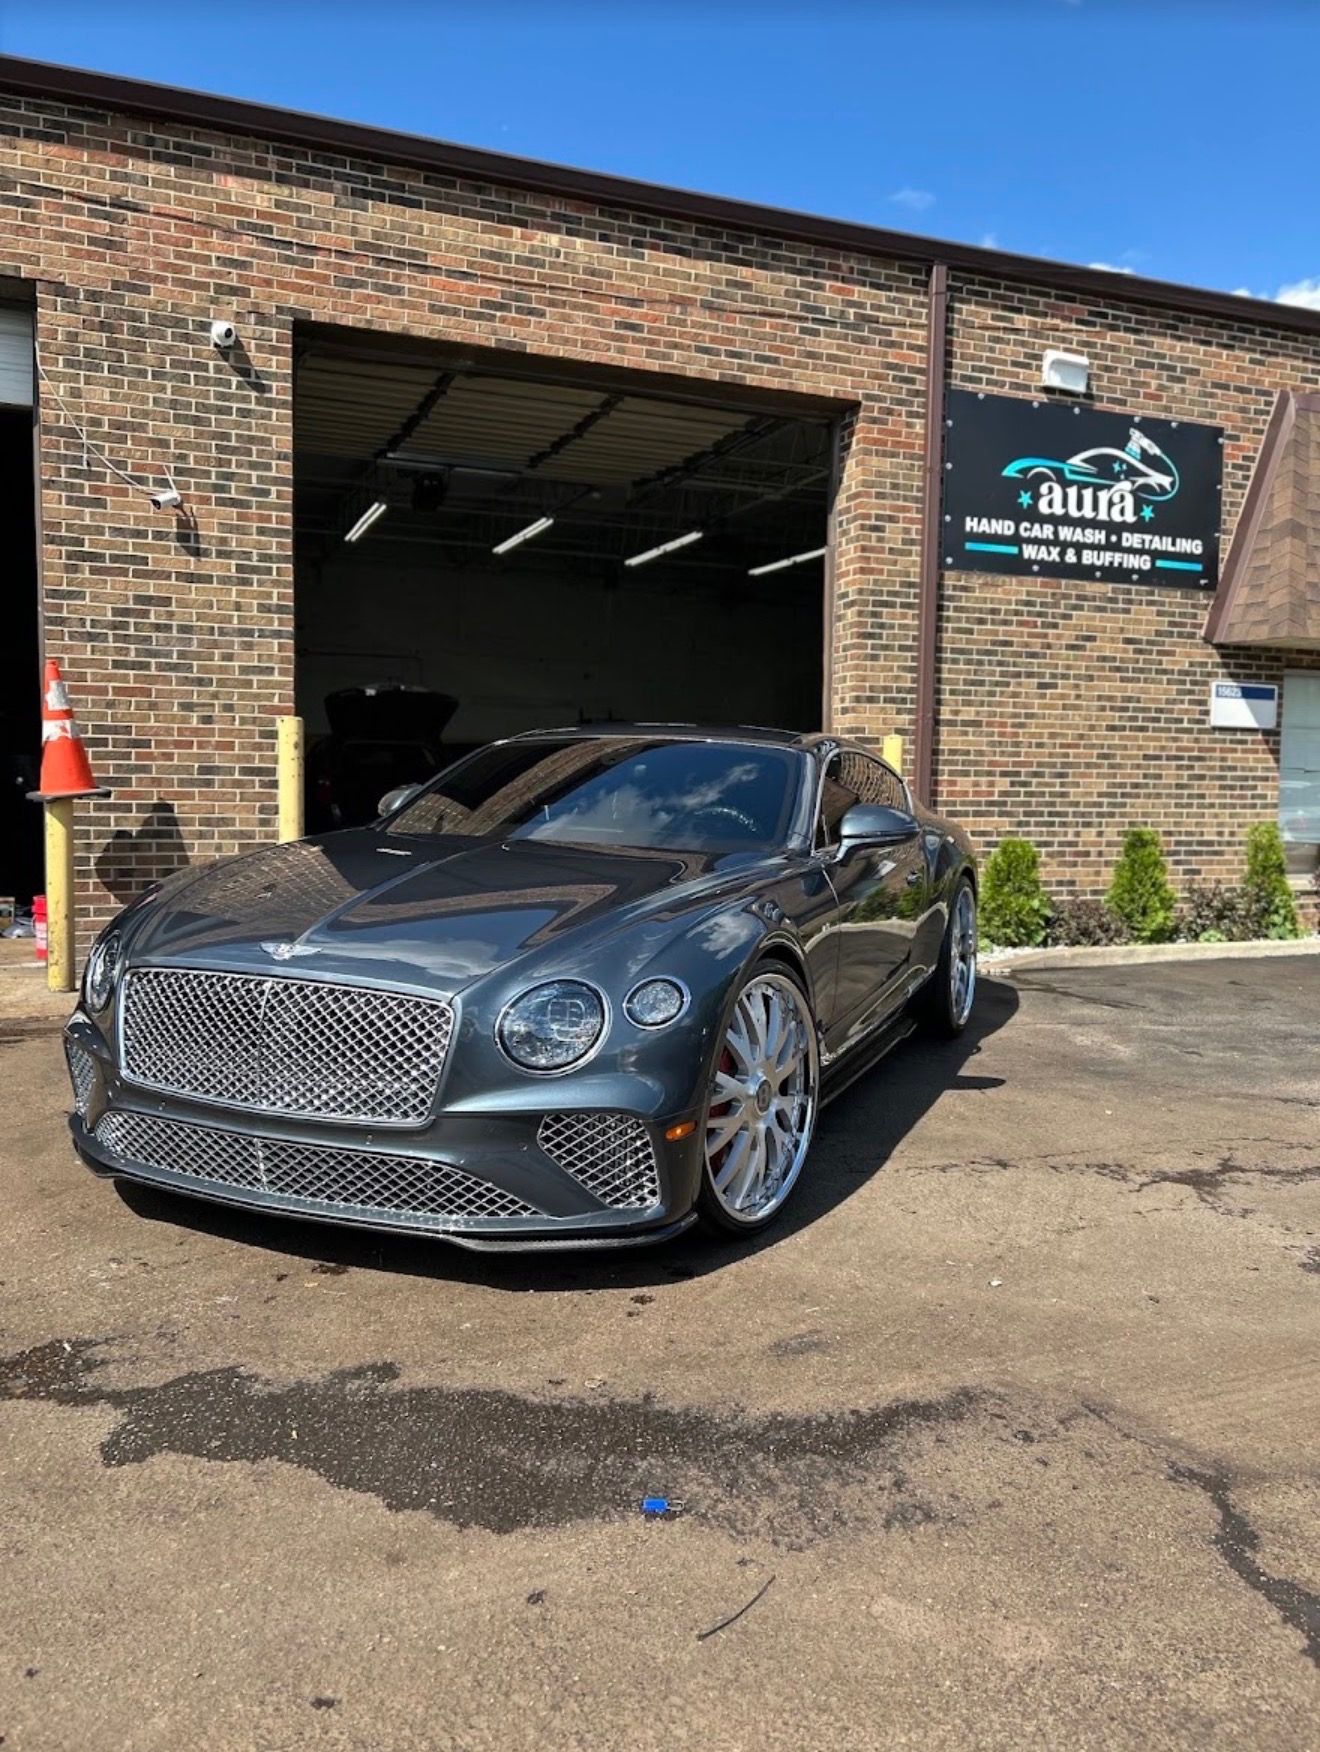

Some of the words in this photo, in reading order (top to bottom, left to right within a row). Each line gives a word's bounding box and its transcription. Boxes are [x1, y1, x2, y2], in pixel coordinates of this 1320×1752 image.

[1037, 481, 1137, 523] aura
[965, 516, 1015, 536] HAND
[1019, 521, 1055, 540] CAR
[1058, 525, 1106, 545] WASH
[1121, 532, 1203, 555] DETAILING
[1022, 543, 1061, 563] WAX
[1064, 547, 1078, 564] &
[1081, 549, 1152, 571] BUFFING
